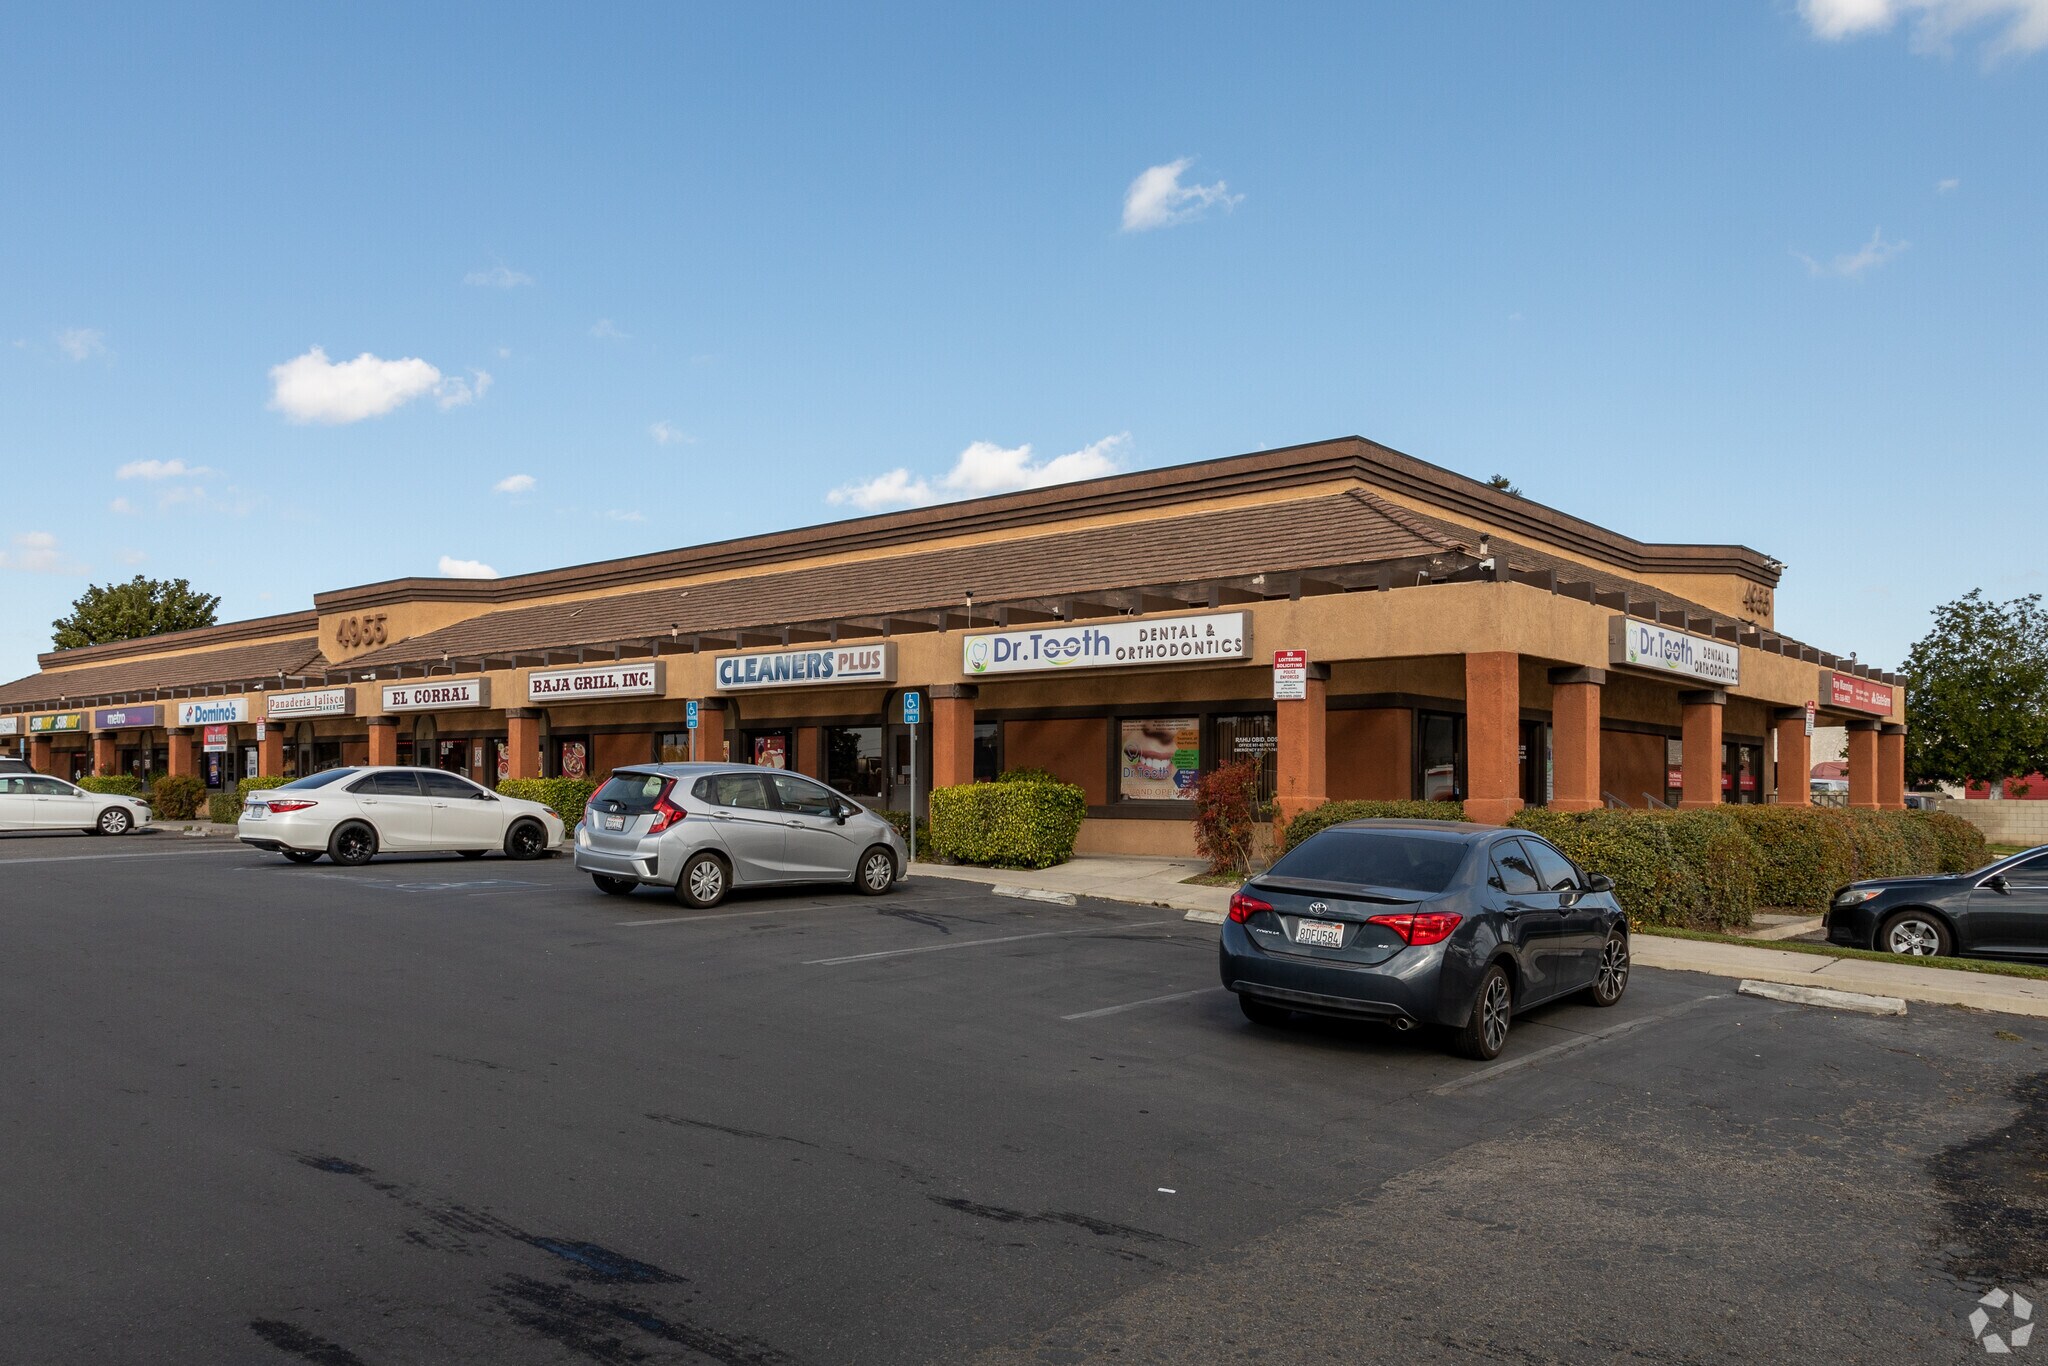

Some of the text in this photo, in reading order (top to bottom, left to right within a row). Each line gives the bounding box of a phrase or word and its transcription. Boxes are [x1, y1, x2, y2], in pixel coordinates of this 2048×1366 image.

[1743, 582, 1771, 616] 4955
[336, 613, 388, 648] 4955
[1139, 623, 1215, 642] DENTAL &
[1115, 638, 1242, 661] ORTHODONTICS
[1703, 646, 1730, 664] DENTAL &
[719, 650, 881, 686] CLEANERS PLUS
[1694, 660, 1738, 680] ORTHODONTICS
[533, 672, 652, 693] BAJA GRILL, INC.
[269, 694, 344, 711] Panaderia Jalisco
[392, 687, 469, 705] EL CORRAL
[107, 711, 126, 724] metro
[195, 702, 236, 722] Domino's
[31, 716, 54, 731] SUBWAY
[55, 714, 80, 729] SUBWAY
[1300, 927, 1339, 943] 8DFU584
